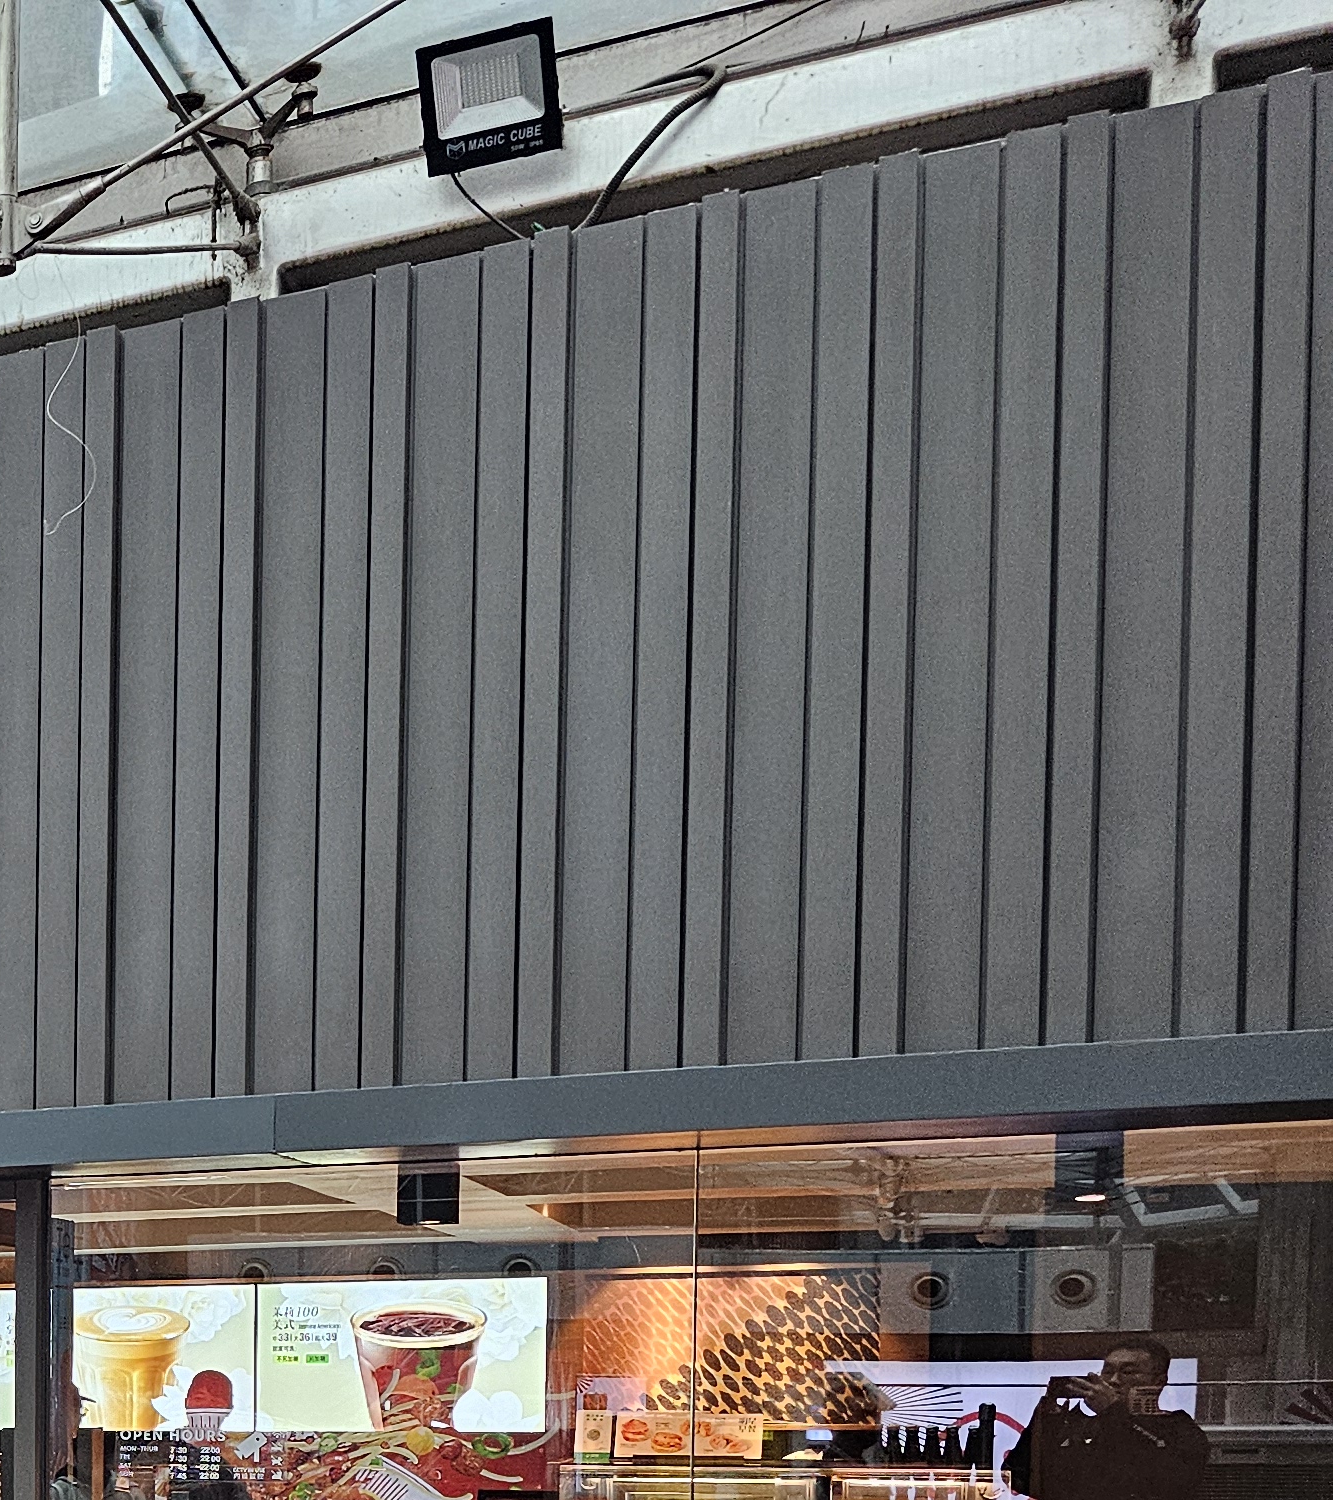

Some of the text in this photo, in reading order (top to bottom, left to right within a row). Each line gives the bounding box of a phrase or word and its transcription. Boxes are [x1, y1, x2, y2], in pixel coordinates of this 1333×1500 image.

[468, 124, 542, 151] MAGIC CUBE
[119, 1430, 226, 1442] OPEN HOURS
